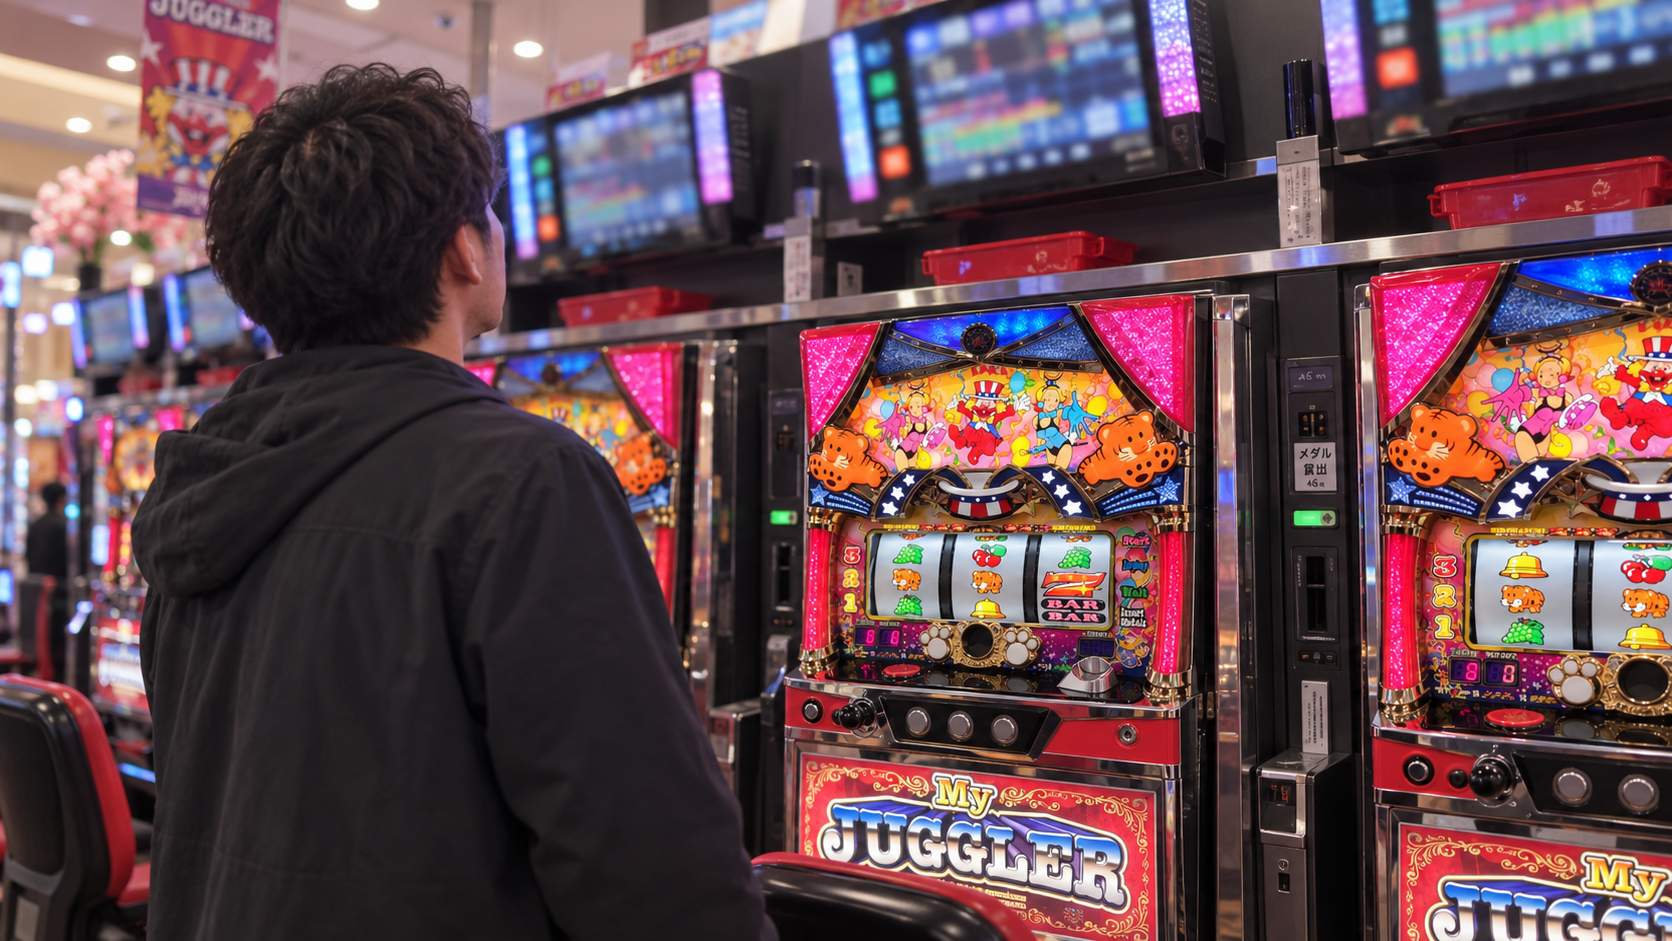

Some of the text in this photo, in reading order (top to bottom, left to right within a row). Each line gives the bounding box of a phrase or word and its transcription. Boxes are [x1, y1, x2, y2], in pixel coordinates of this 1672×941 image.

[1299, 447, 1332, 460] メダル
[1303, 463, 1327, 476] 貸出
[1433, 555, 1457, 577] 3
[843, 593, 858, 613] 1
[1046, 599, 1099, 610] BAR
[1432, 584, 1456, 608] 2
[1434, 615, 1454, 639] 1
[935, 776, 994, 816] My
[821, 804, 1128, 908] JUGGLER
[1585, 856, 1668, 902] My
[1432, 881, 1672, 941] JUGG
